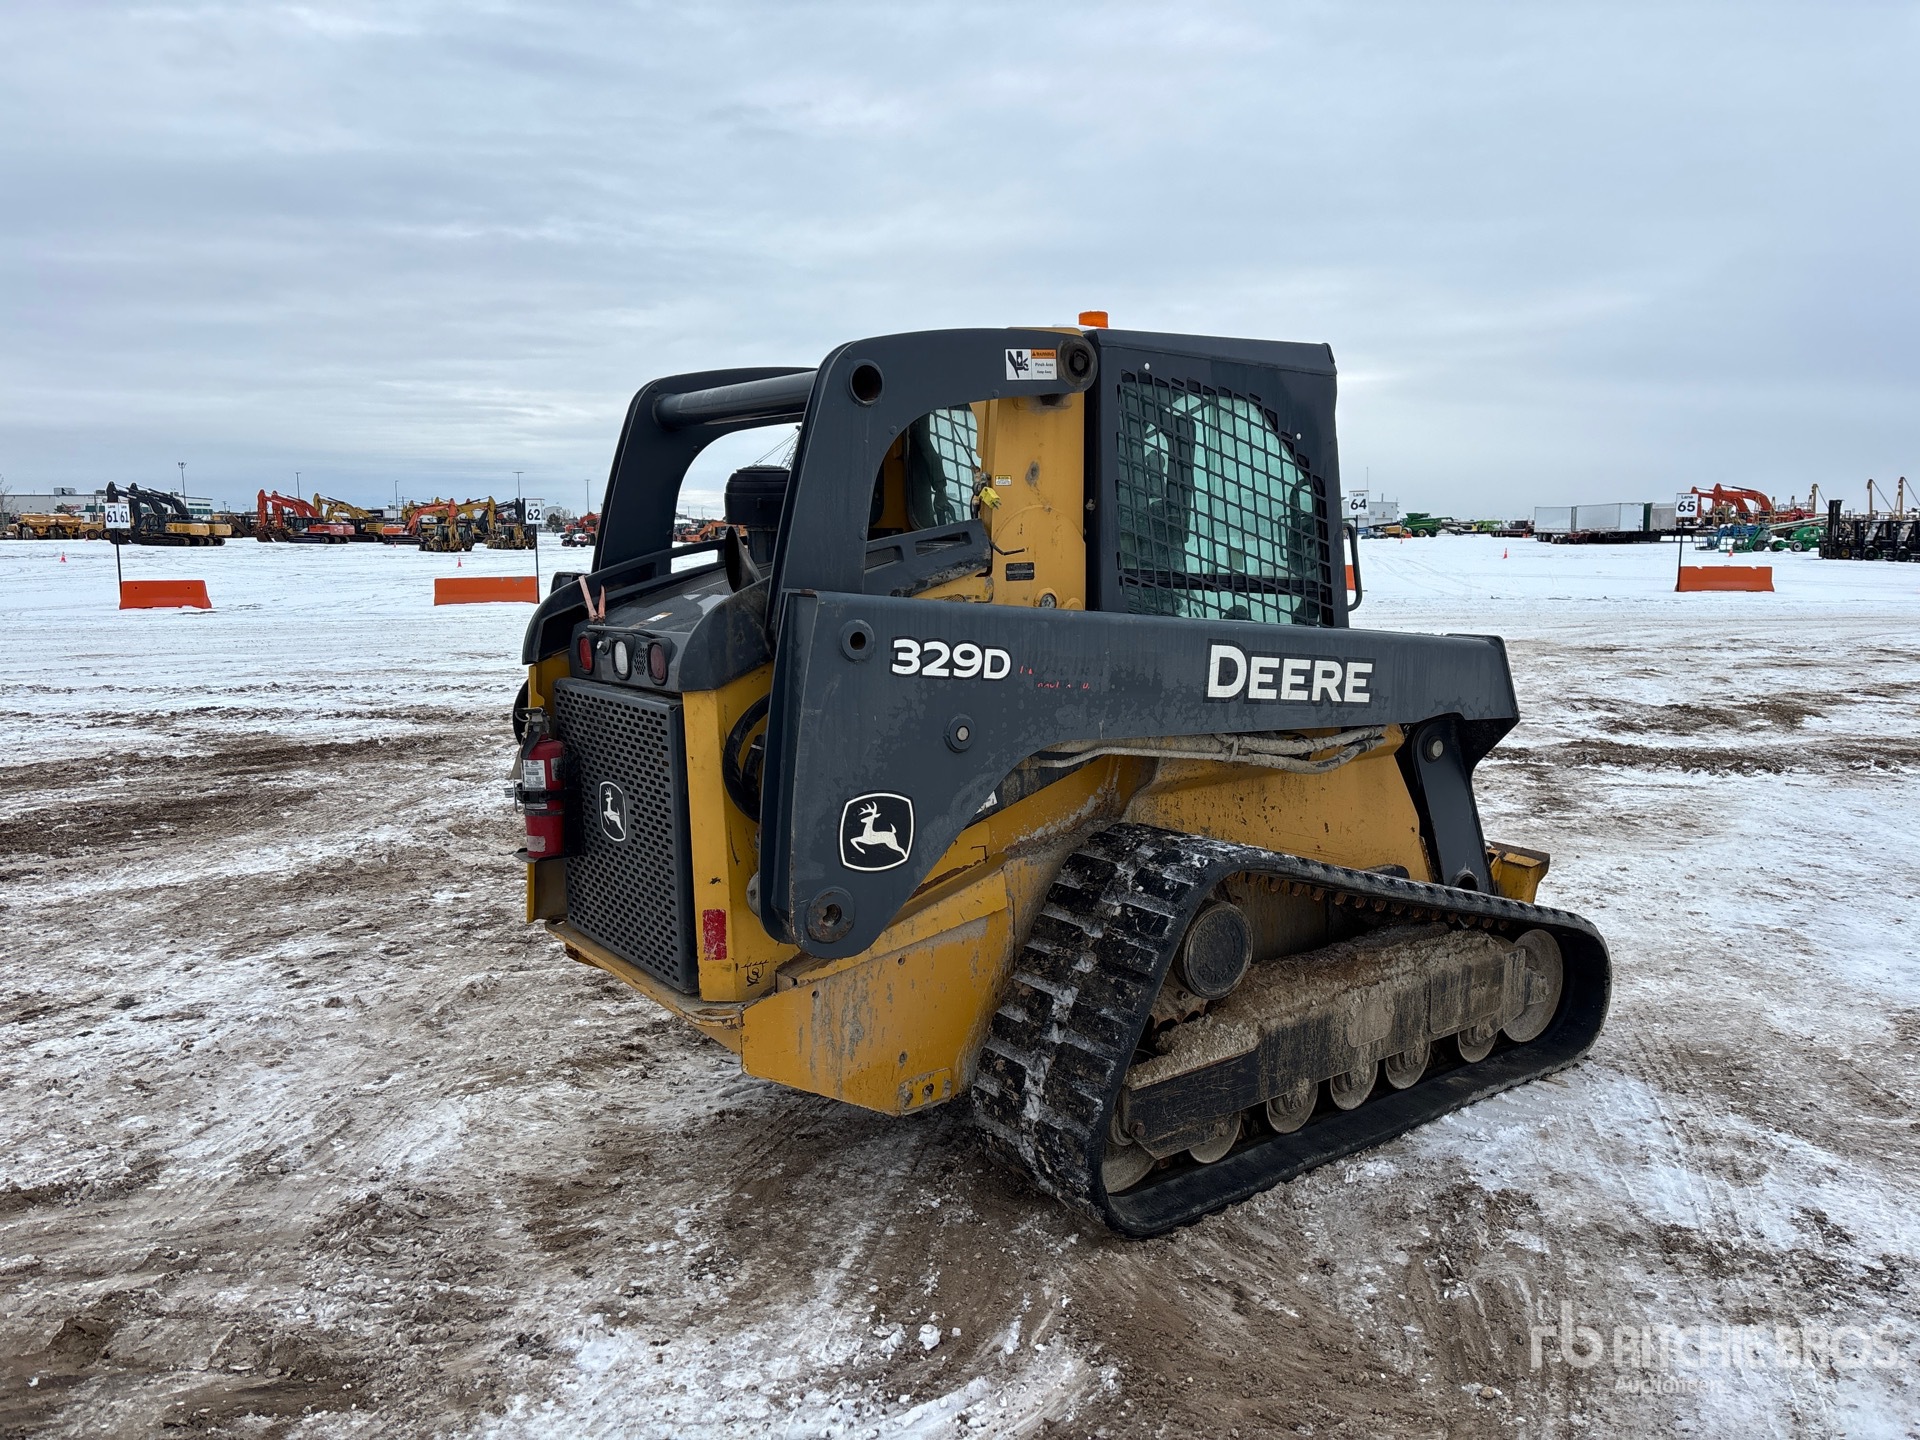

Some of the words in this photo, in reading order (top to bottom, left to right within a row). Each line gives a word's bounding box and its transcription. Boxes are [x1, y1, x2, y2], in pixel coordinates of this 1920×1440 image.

[1350, 498, 1367, 510] 64
[1677, 501, 1696, 512] 65
[106, 511, 118, 523] 61
[120, 511, 129, 523] 61
[527, 508, 541, 520] 62
[891, 638, 1011, 680] 329D
[1207, 644, 1373, 703] DEERE
